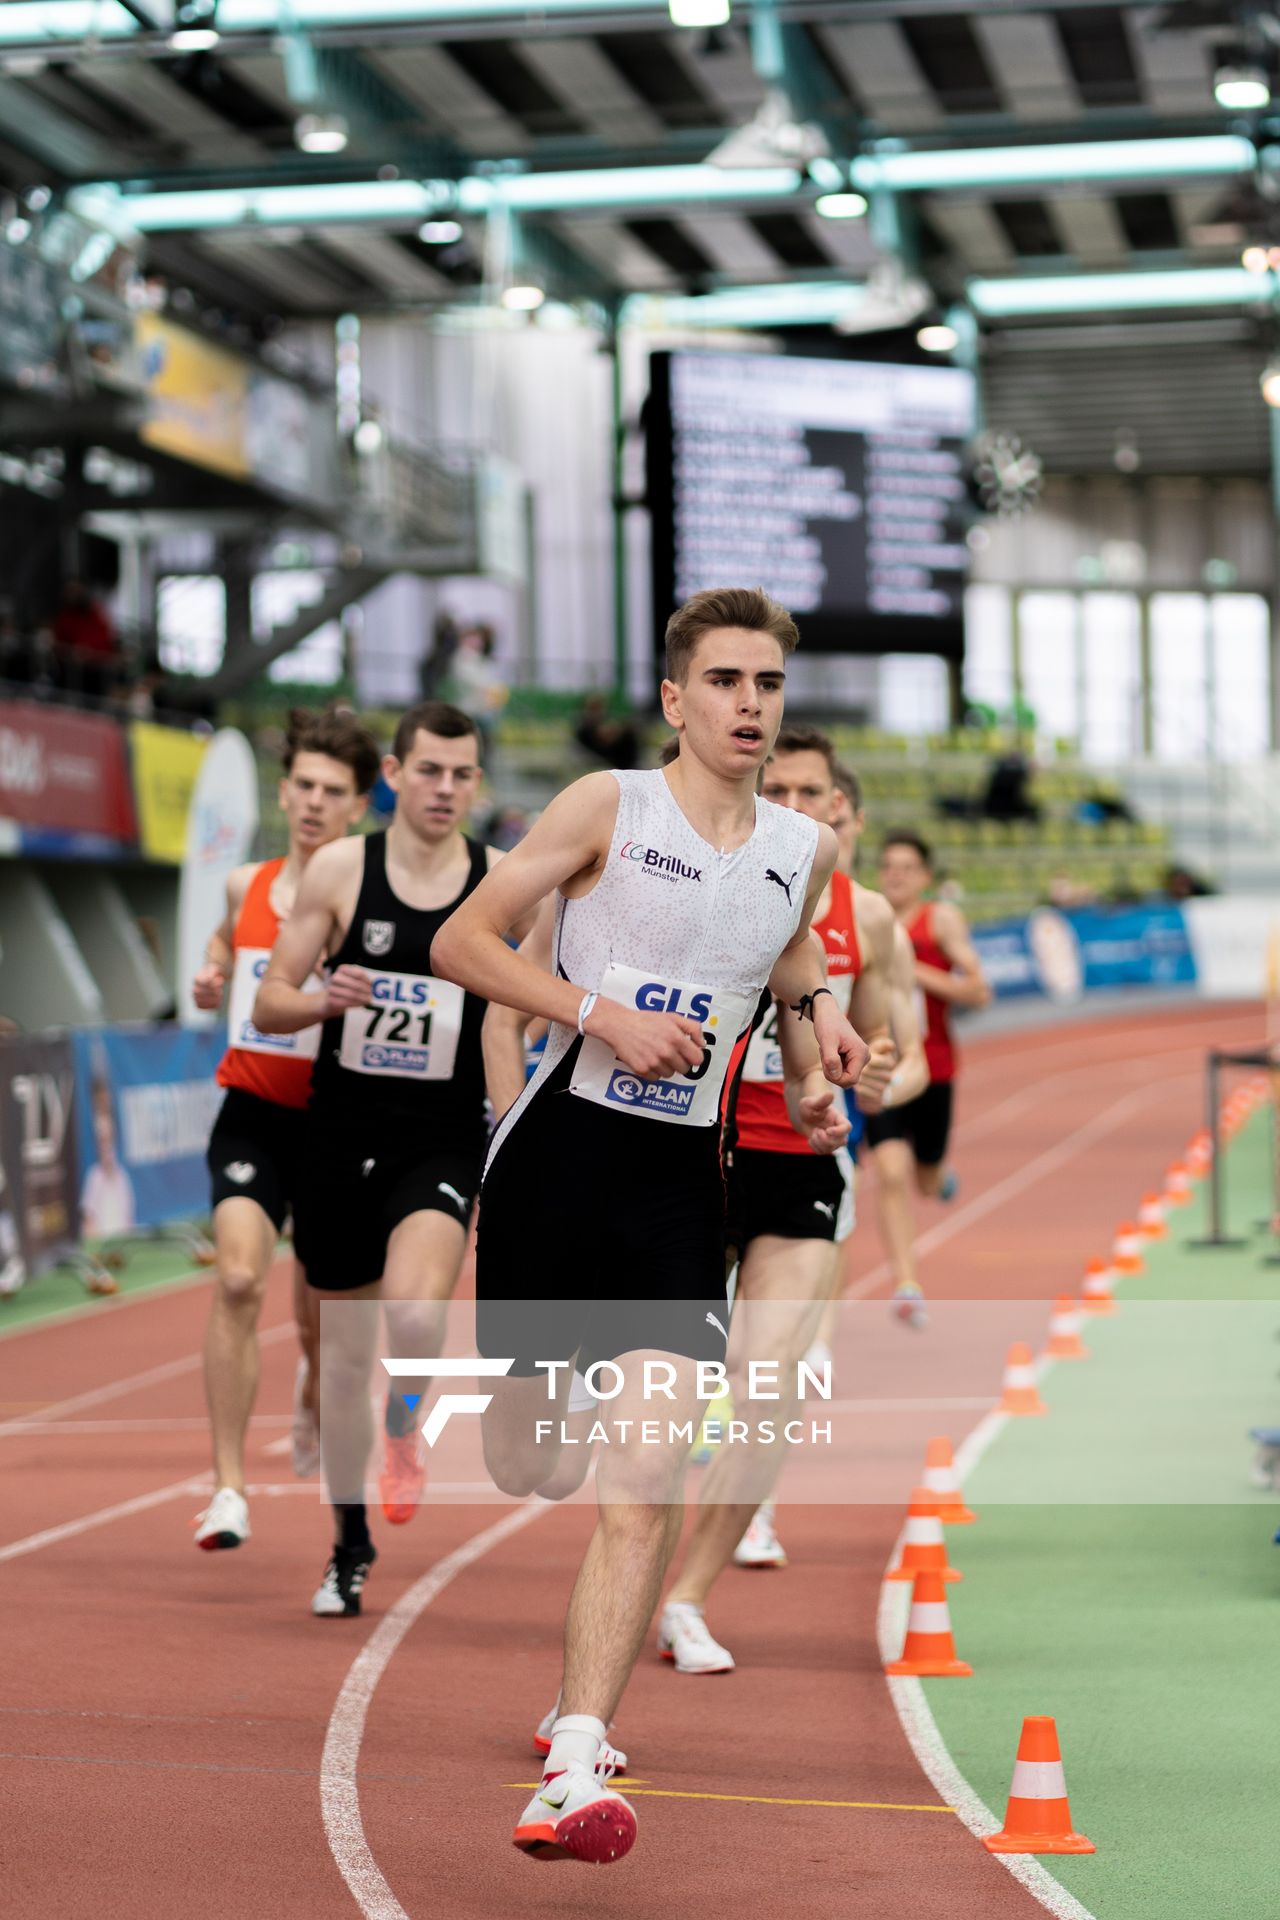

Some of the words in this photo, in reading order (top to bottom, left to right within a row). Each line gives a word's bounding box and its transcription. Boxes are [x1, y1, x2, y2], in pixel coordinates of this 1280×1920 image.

[641, 866, 680, 884] Münster
[364, 1005, 433, 1045] 721
[644, 1084, 692, 1105] PLAN
[642, 1099, 687, 1113] INTERNATIONAL
